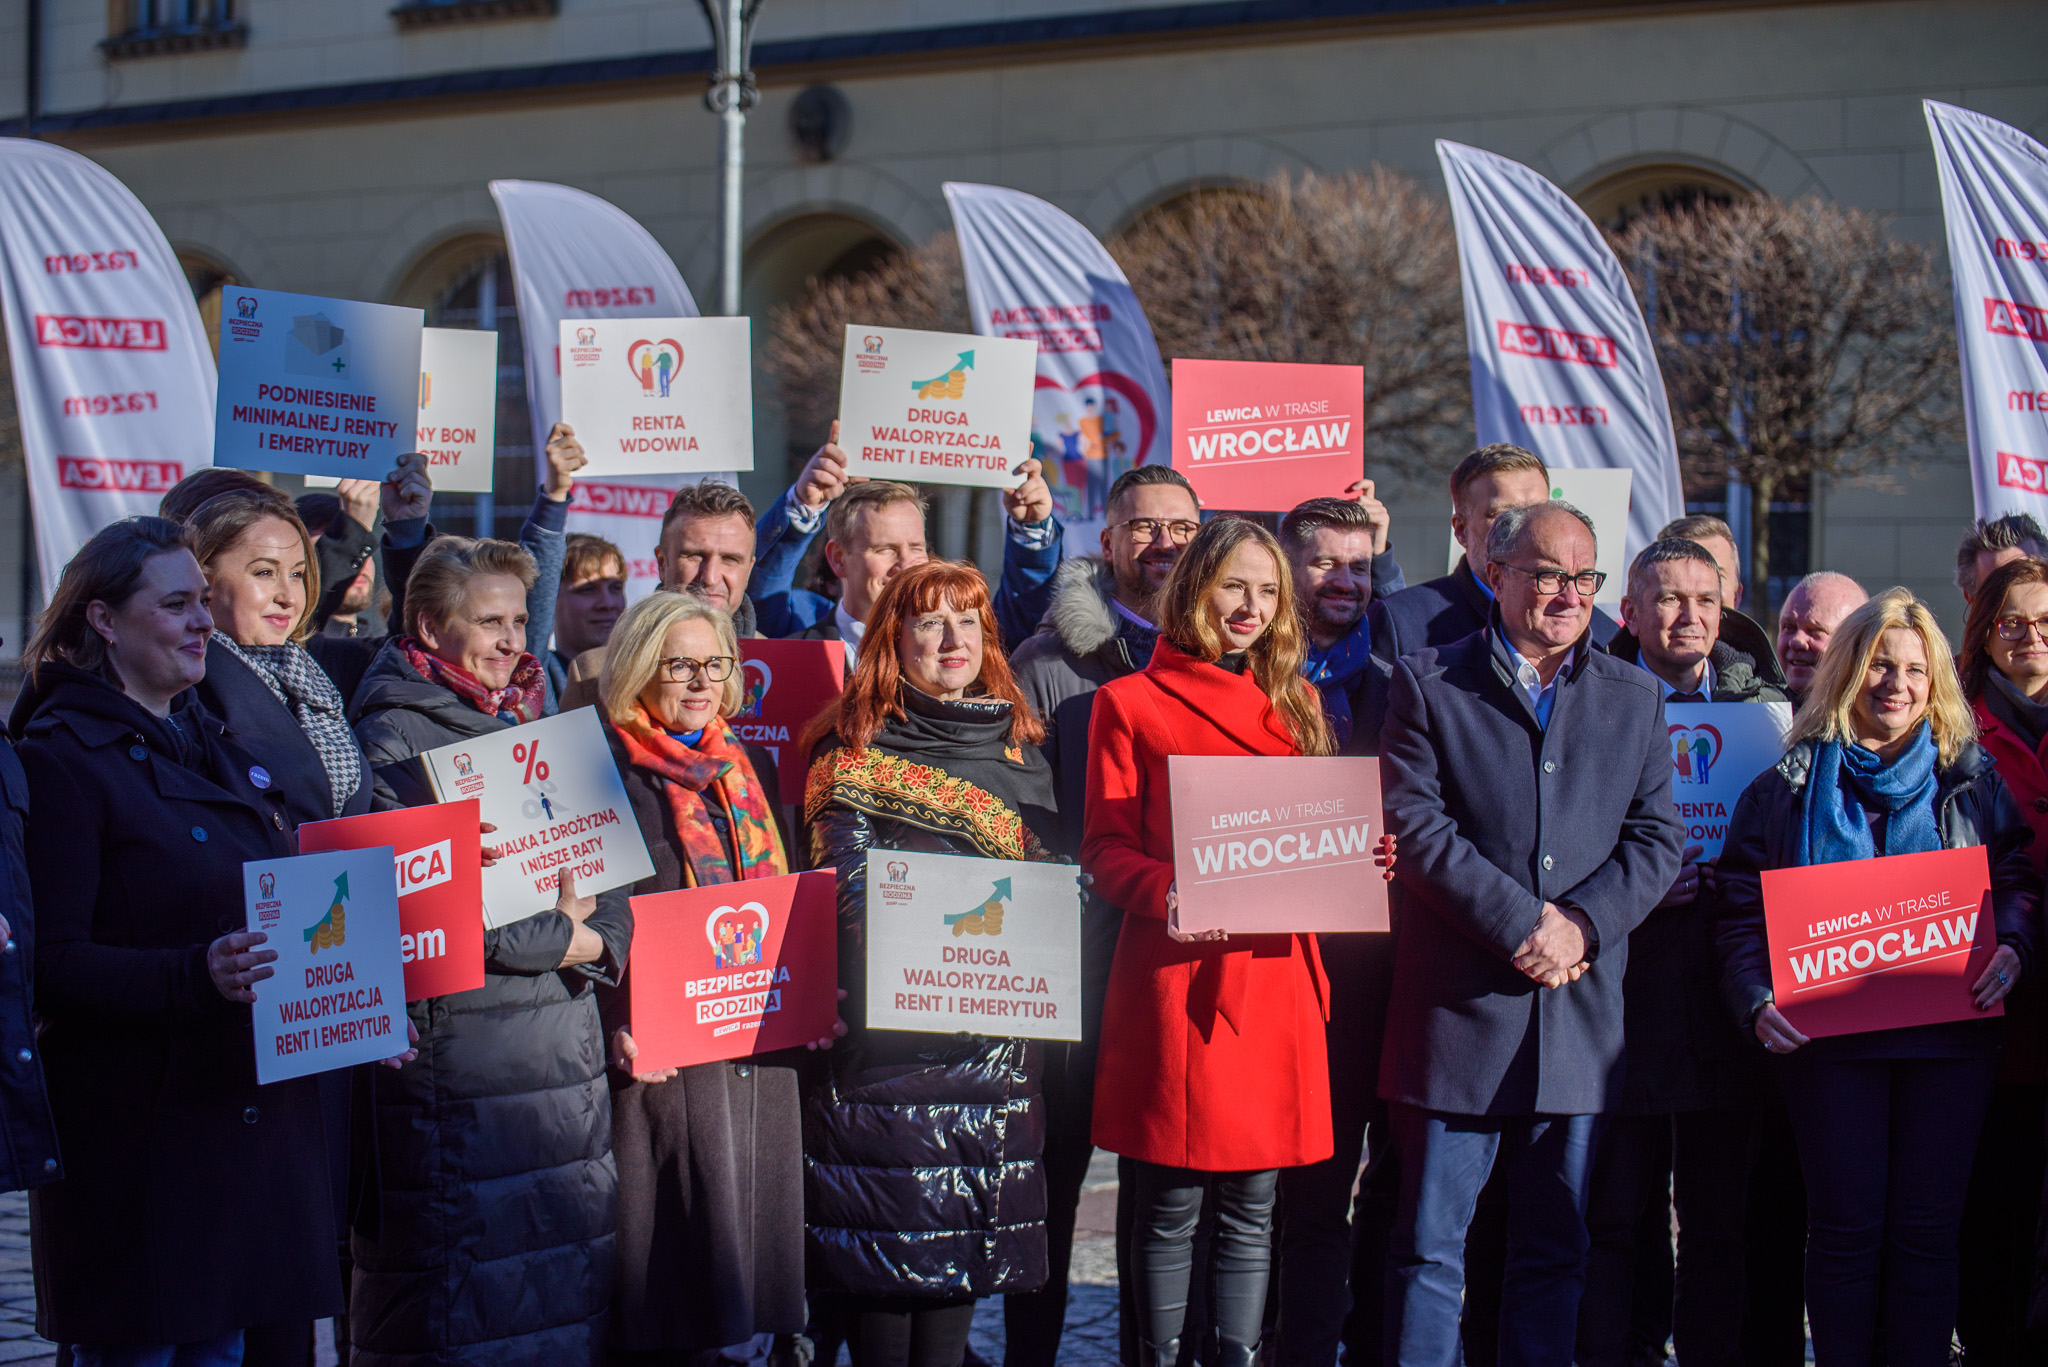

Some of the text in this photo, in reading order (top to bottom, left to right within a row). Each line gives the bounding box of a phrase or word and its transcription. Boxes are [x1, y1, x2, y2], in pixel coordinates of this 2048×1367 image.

[258, 383, 377, 413] PODNIESIENIE
[1206, 400, 1330, 423] LEWICA W TRASIE
[232, 404, 340, 433] MINIMALNEJ
[344, 418, 399, 439] RENTY
[632, 415, 686, 431] RENTA
[907, 408, 969, 426] DRUGA
[259, 432, 371, 460] I EMERYTURY
[441, 427, 476, 444] BON
[620, 437, 700, 453] WDOWIA
[871, 425, 1002, 450] WALORYZACJA
[1188, 422, 1351, 460] WROCŁAW
[862, 446, 1008, 471] RENT I EMERYTUR
[730, 725, 791, 742] ECZNA
[250, 771, 270, 783] razem
[1211, 798, 1345, 830] LEWICA W TRASIE
[1673, 802, 1728, 818] ENTA
[539, 830, 550, 845] Z
[549, 808, 621, 842] DROŻYZNĄ
[520, 836, 604, 876] I NIŻSZE RATY
[1192, 823, 1370, 875] WROCŁAW
[395, 849, 446, 889] ICA
[534, 857, 606, 894] KREYTÓW
[879, 883, 916, 891] BEZPIECZNA
[883, 891, 913, 900] RODZINA
[1808, 890, 1951, 938] LEWICA W TRASIE
[942, 946, 1011, 967] DRUGA
[1789, 911, 1978, 984] WROCŁAW
[305, 961, 355, 989] DRUGA
[685, 965, 791, 998] BEZPIECZNA
[903, 968, 1049, 994] WALORYZACJA
[279, 986, 384, 1024] WALORYZACJA
[700, 992, 779, 1020] RODZINA
[895, 992, 1058, 1019] RENT I EMERYTUR
[275, 1014, 392, 1056] RENT I EMERYTUR
[715, 1019, 766, 1035] LEWICA razem
